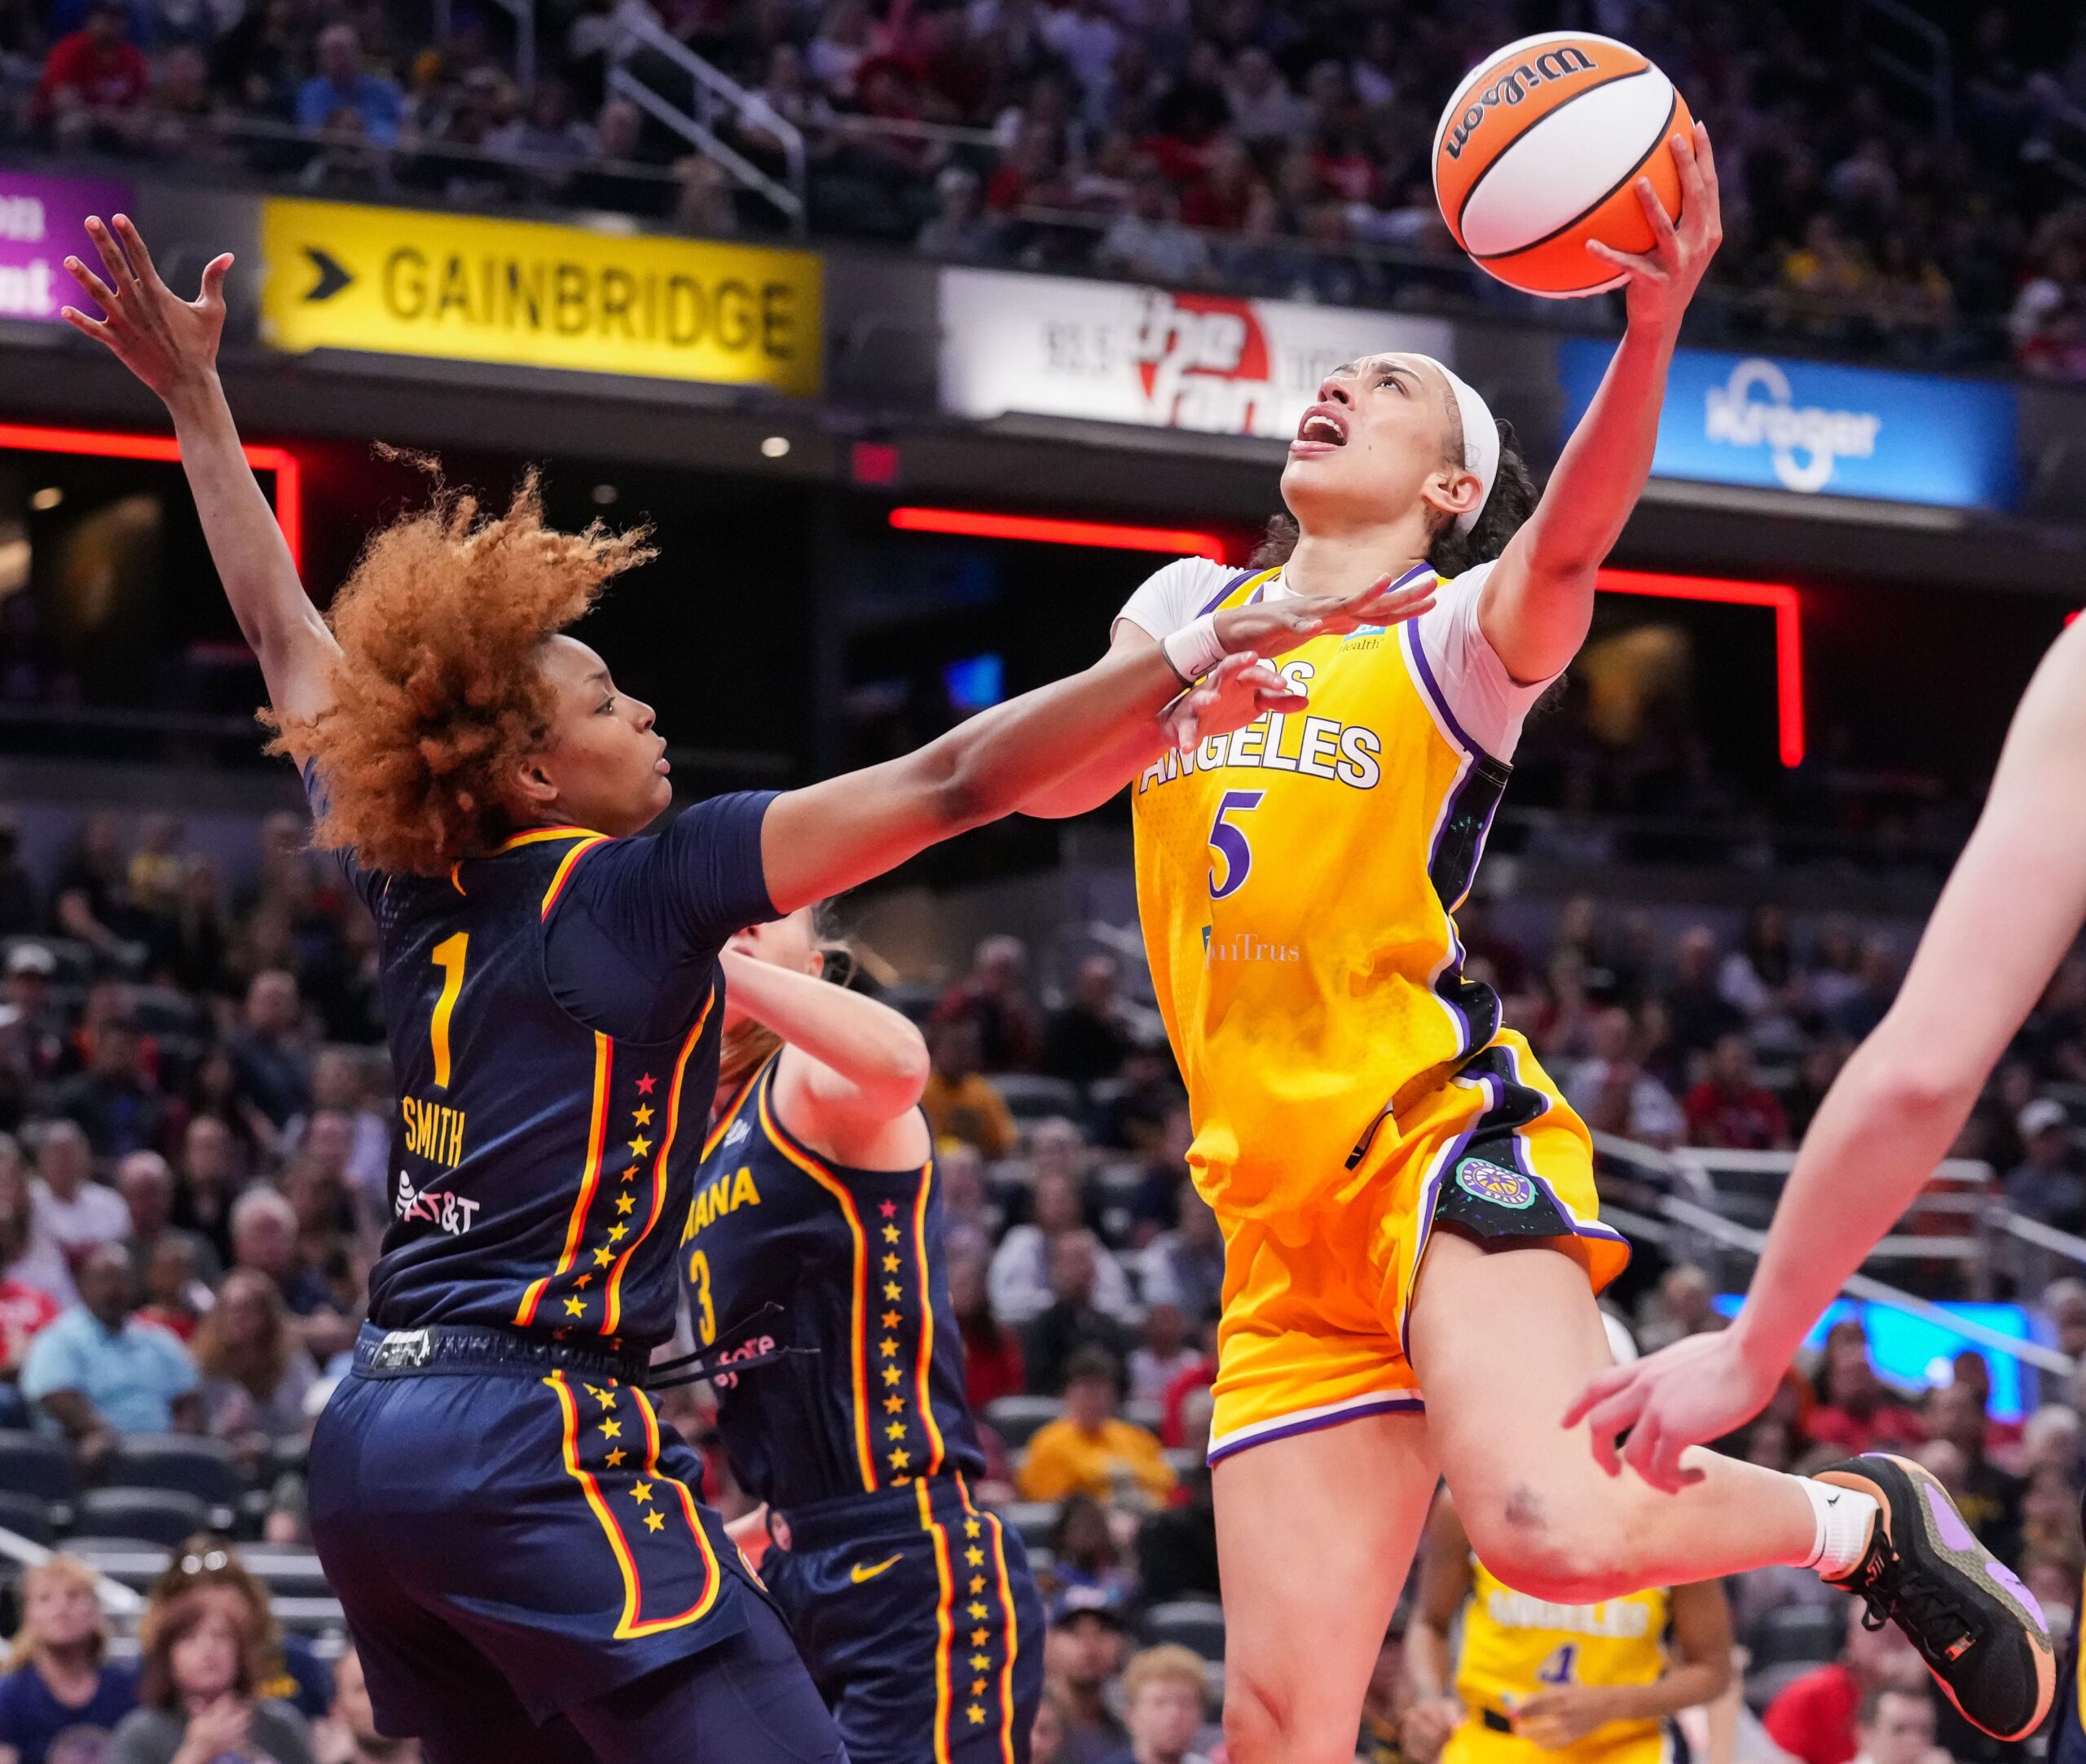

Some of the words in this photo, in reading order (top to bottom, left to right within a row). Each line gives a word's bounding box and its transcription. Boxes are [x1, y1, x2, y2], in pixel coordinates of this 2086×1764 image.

[1446, 46, 1599, 160] Wilson
[381, 245, 794, 360] GAINBRIDGE
[1706, 359, 1881, 492] Kroger
[1208, 790, 1267, 900] 5
[431, 931, 469, 1089] 1
[403, 1096, 465, 1168] SMITH
[404, 1190, 480, 1236] AT&T
[680, 1166, 761, 1249] IANA
